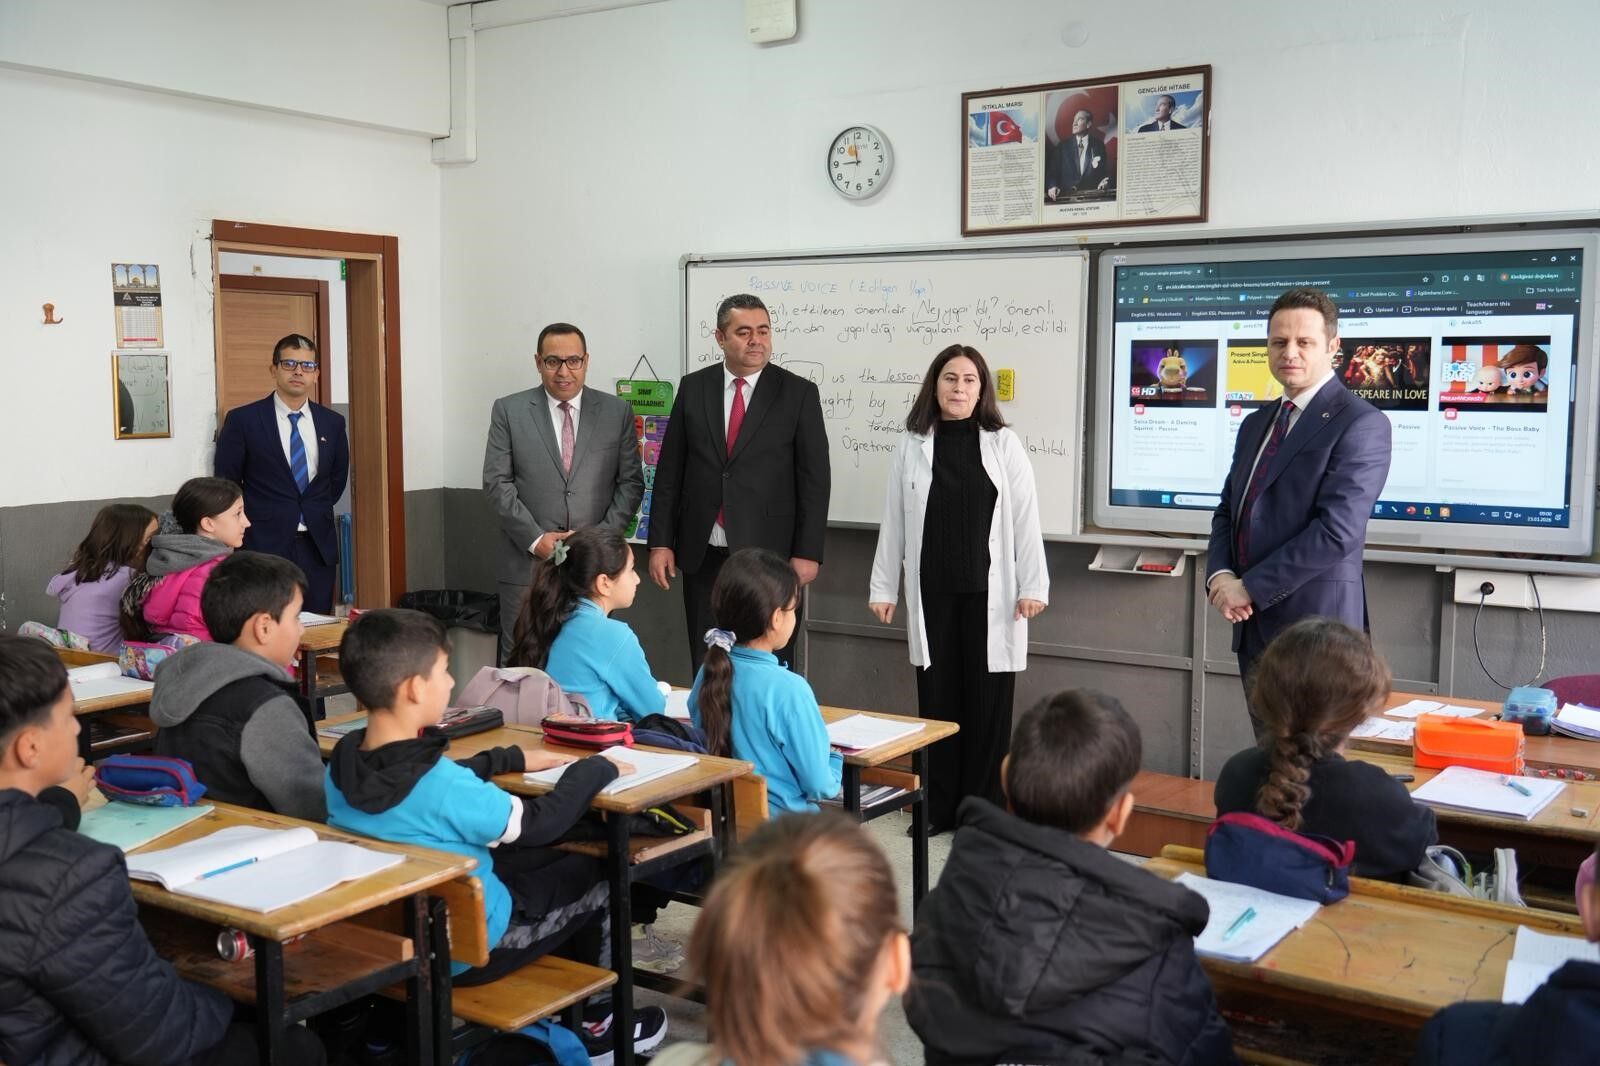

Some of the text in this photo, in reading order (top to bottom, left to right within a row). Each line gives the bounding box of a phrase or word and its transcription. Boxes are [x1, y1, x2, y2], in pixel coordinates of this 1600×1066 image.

[845, 181, 850, 189] 7
[750, 276, 795, 292] PASSIVE
[800, 279, 840, 295] VOICE
[1375, 306, 1393, 314] Upload
[832, 368, 921, 384] us the lesson
[1141, 387, 1156, 396] HD
[1352, 388, 1427, 399] ESPEARE IN LOVE
[868, 390, 886, 418] by
